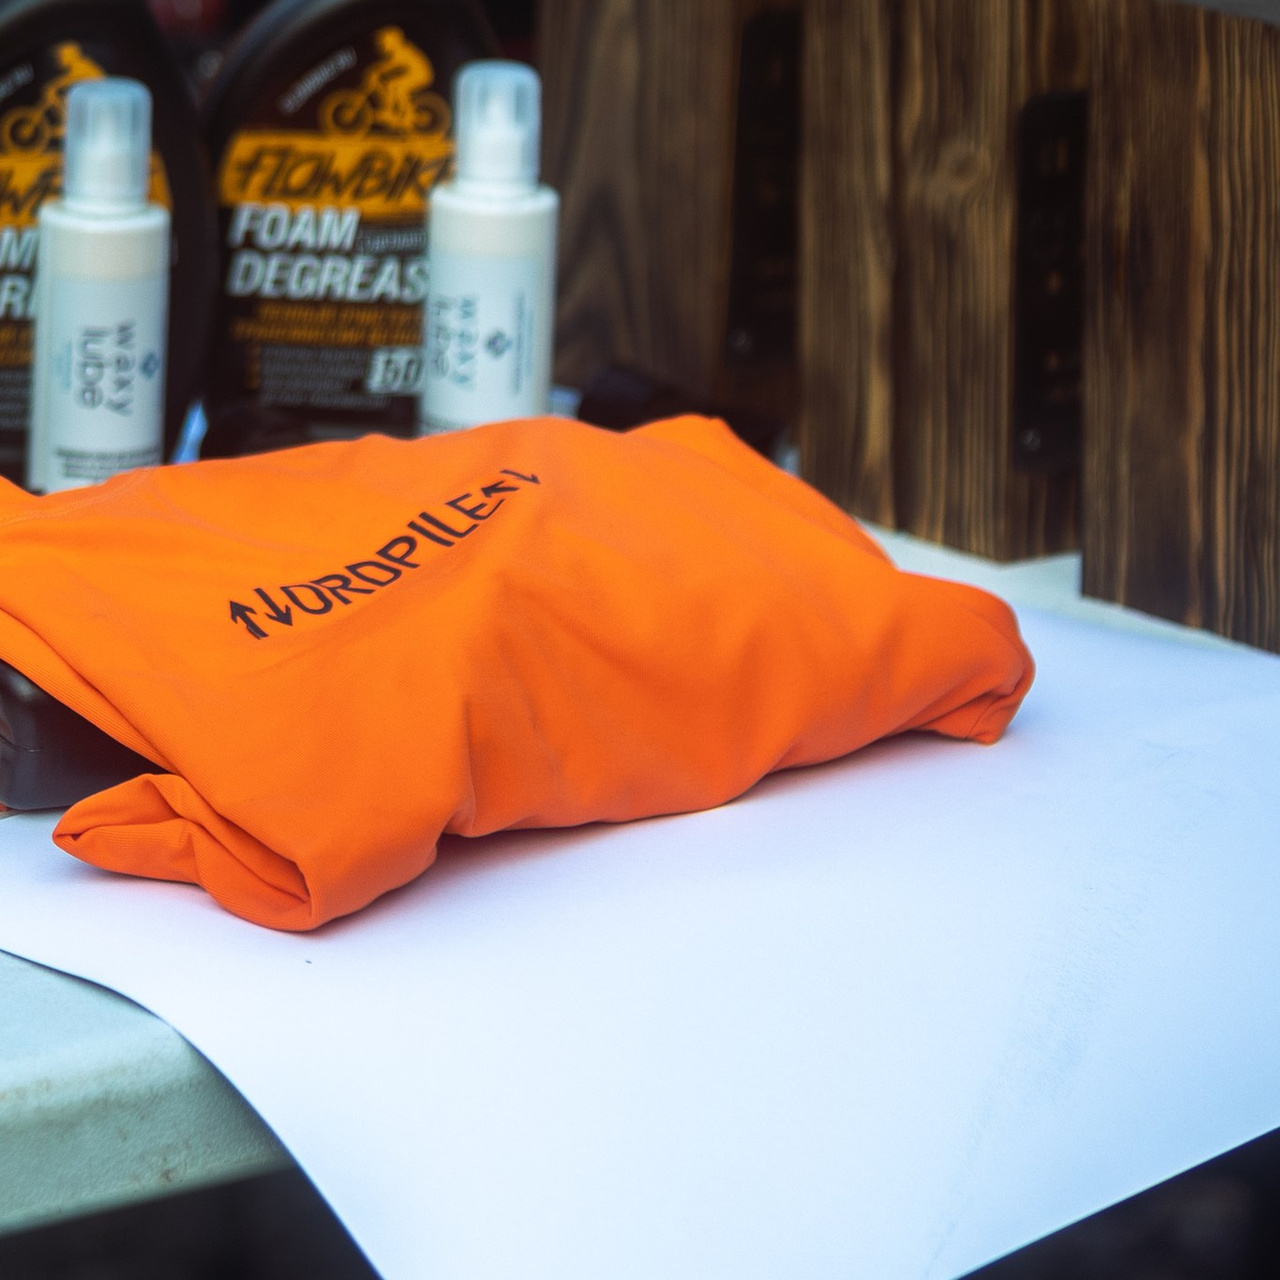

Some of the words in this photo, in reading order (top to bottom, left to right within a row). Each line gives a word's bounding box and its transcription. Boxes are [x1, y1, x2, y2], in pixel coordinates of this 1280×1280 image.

[229, 203, 360, 251] FOAM
[77, 325, 108, 410] lube
[106, 320, 138, 416] waxy
